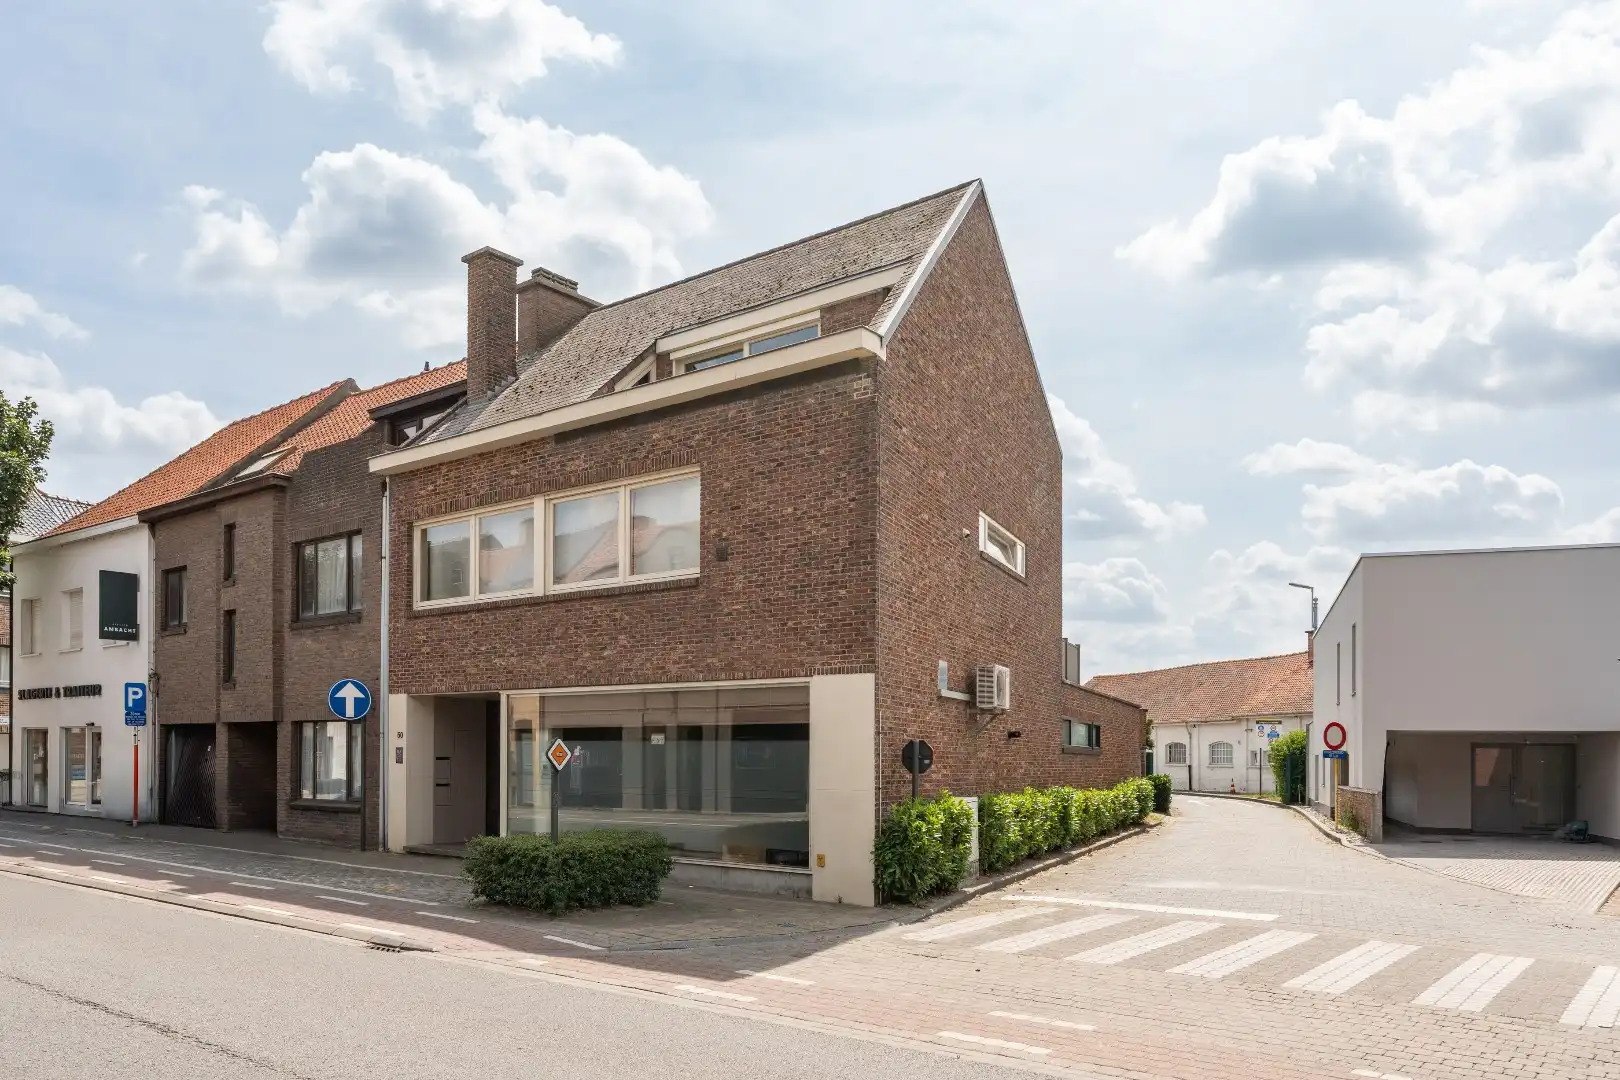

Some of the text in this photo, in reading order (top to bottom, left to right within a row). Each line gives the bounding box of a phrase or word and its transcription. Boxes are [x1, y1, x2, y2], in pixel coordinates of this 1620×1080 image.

[54, 686, 61, 699] &
[62, 684, 102, 697] TRAITEUR
[127, 686, 143, 708] P
